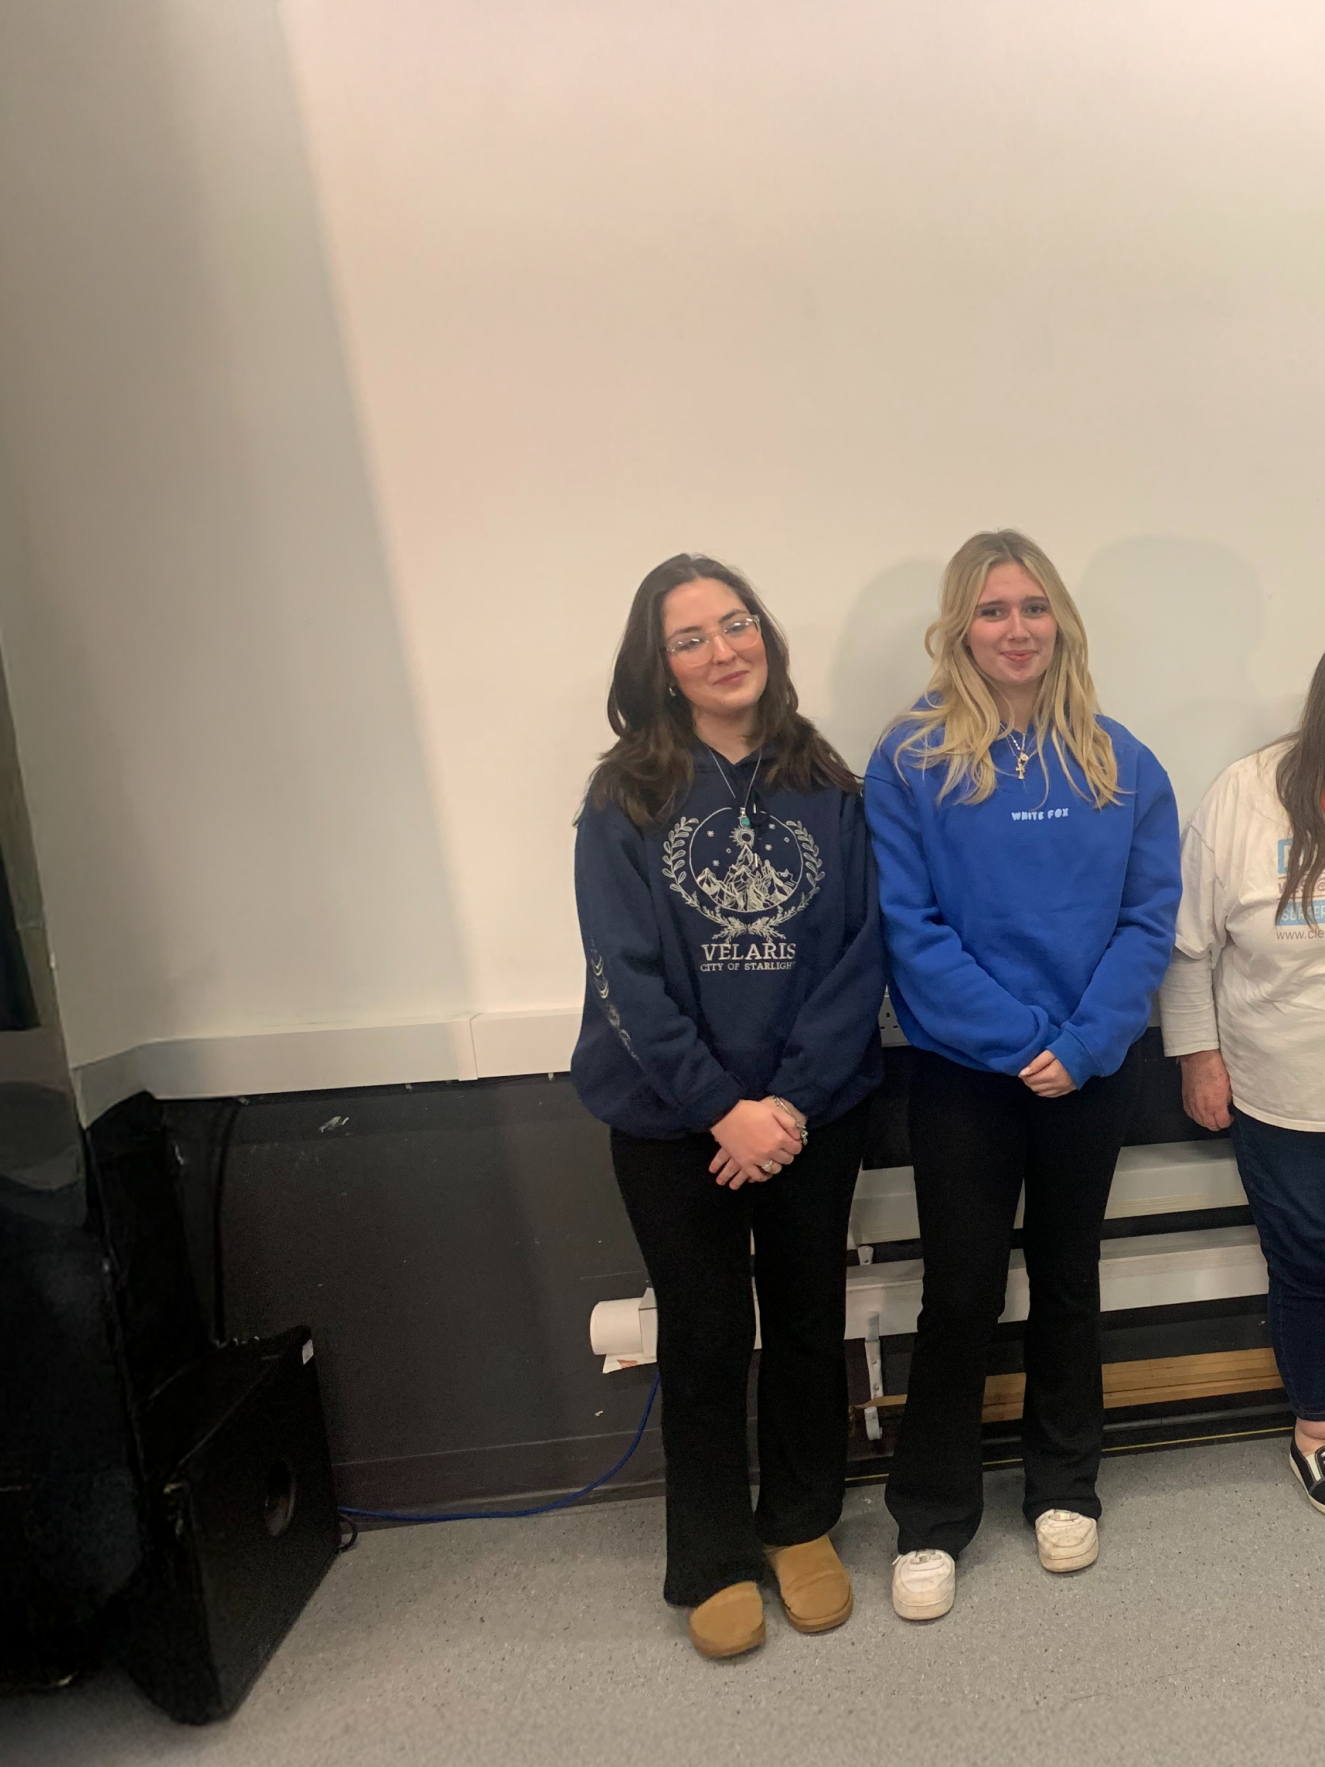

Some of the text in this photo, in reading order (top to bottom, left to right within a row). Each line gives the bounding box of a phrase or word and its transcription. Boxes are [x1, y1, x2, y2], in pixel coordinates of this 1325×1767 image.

[1011, 808, 1069, 821] WHITE FOX
[701, 943, 796, 960] VELARIS
[700, 963, 724, 972] CITY
[727, 962, 740, 971] OF
